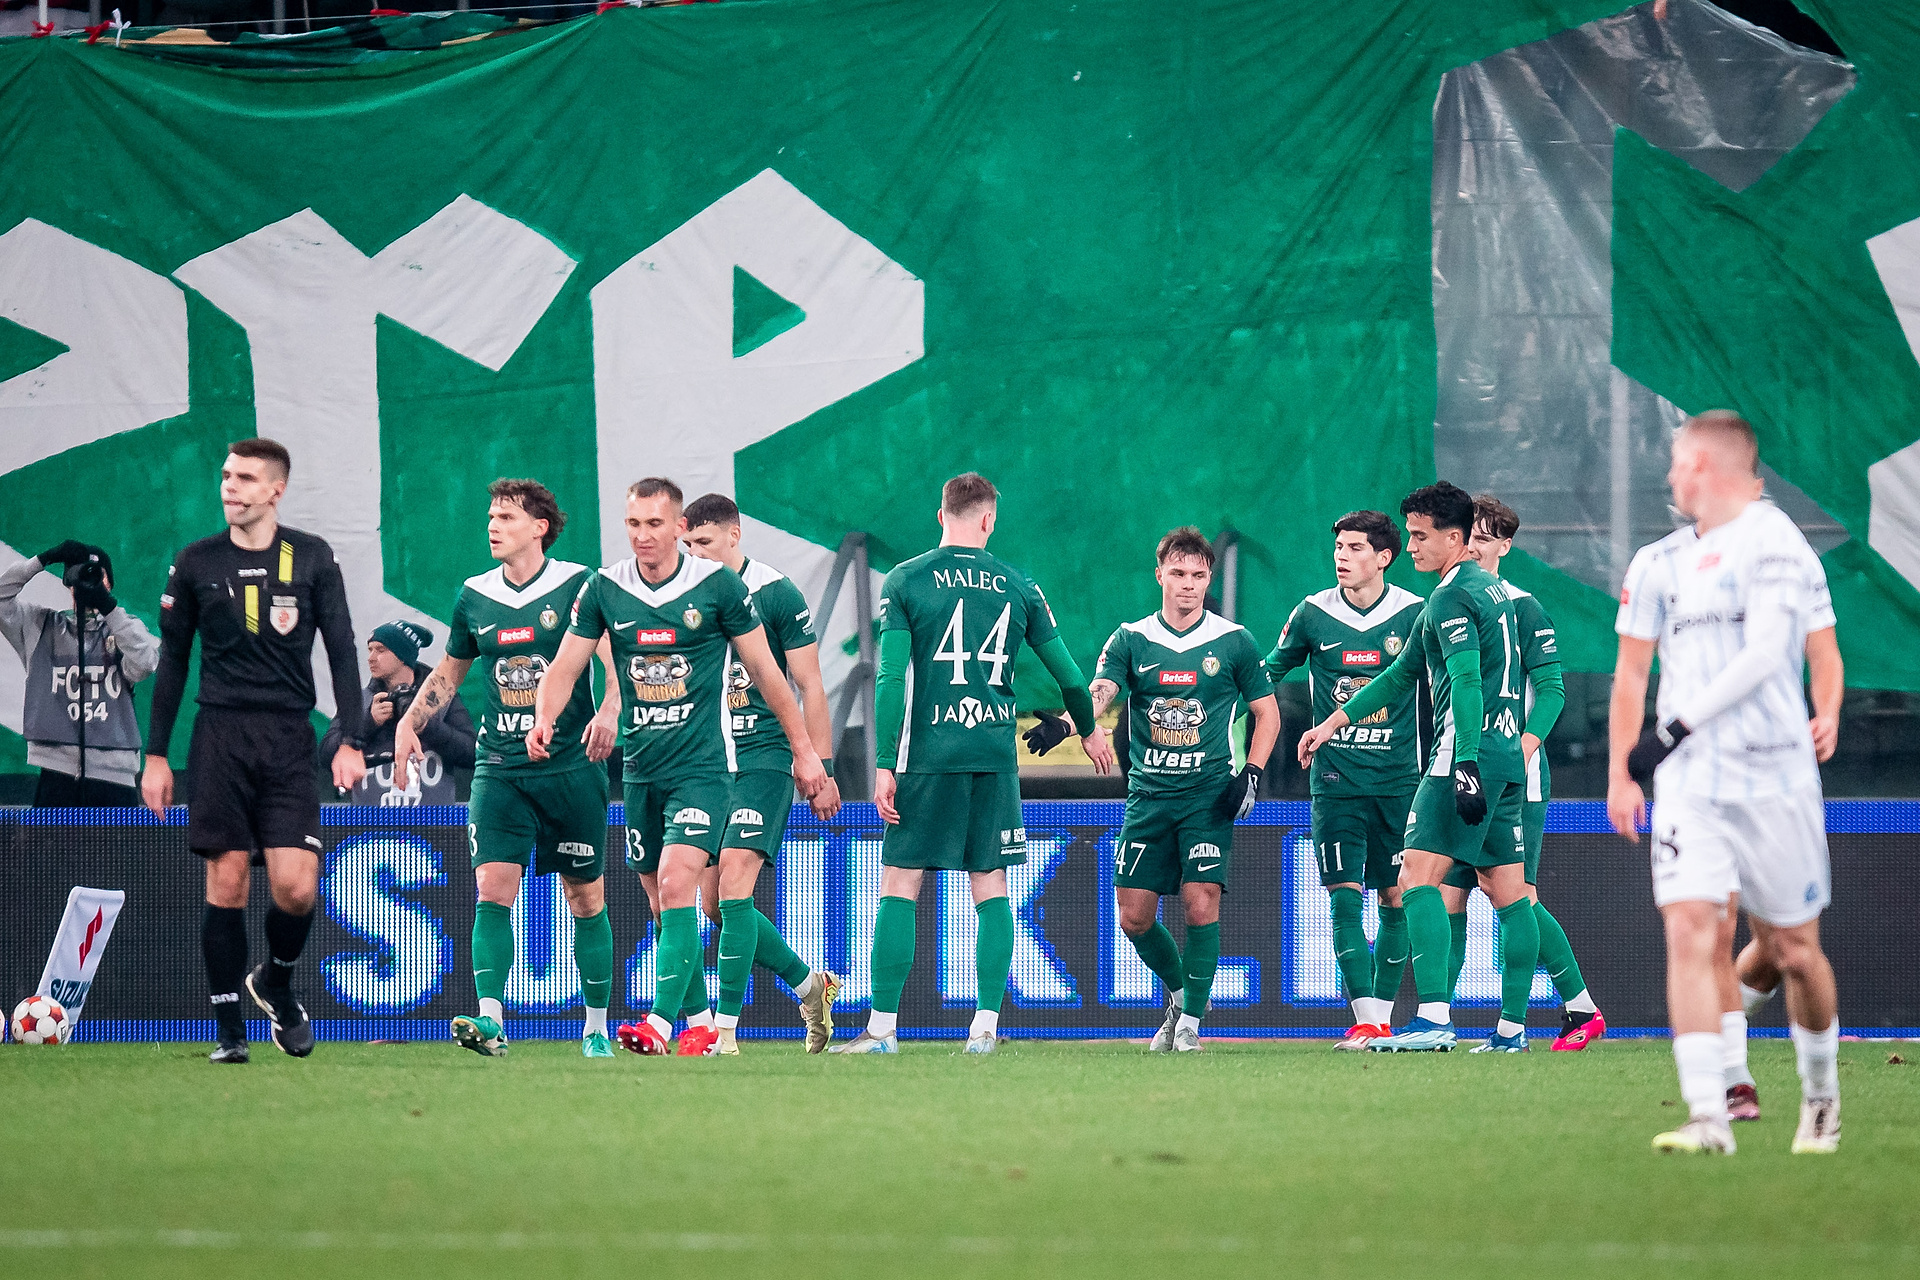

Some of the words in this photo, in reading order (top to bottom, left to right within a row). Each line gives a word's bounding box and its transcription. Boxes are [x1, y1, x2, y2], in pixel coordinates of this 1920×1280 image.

[932, 567, 1007, 594] MALEC
[500, 629, 532, 642] Betclic
[639, 631, 673, 643] Betclic
[932, 597, 1012, 687] 44
[1345, 652, 1378, 663] Betclic
[51, 665, 122, 700] FOTO
[1161, 673, 1194, 683] Betclic
[499, 688, 539, 706] VIKIN
[634, 680, 688, 702] VIKINGA
[67, 701, 109, 723] 054
[632, 703, 694, 726] LVBET
[931, 695, 1016, 730] JAXAN
[1150, 725, 1200, 746] VIKINGA
[1143, 748, 1206, 768] LVBET
[361, 750, 443, 791] FOO
[1115, 840, 1147, 876] 47
[1188, 842, 1221, 860] ACANA
[1319, 841, 1343, 873] 11
